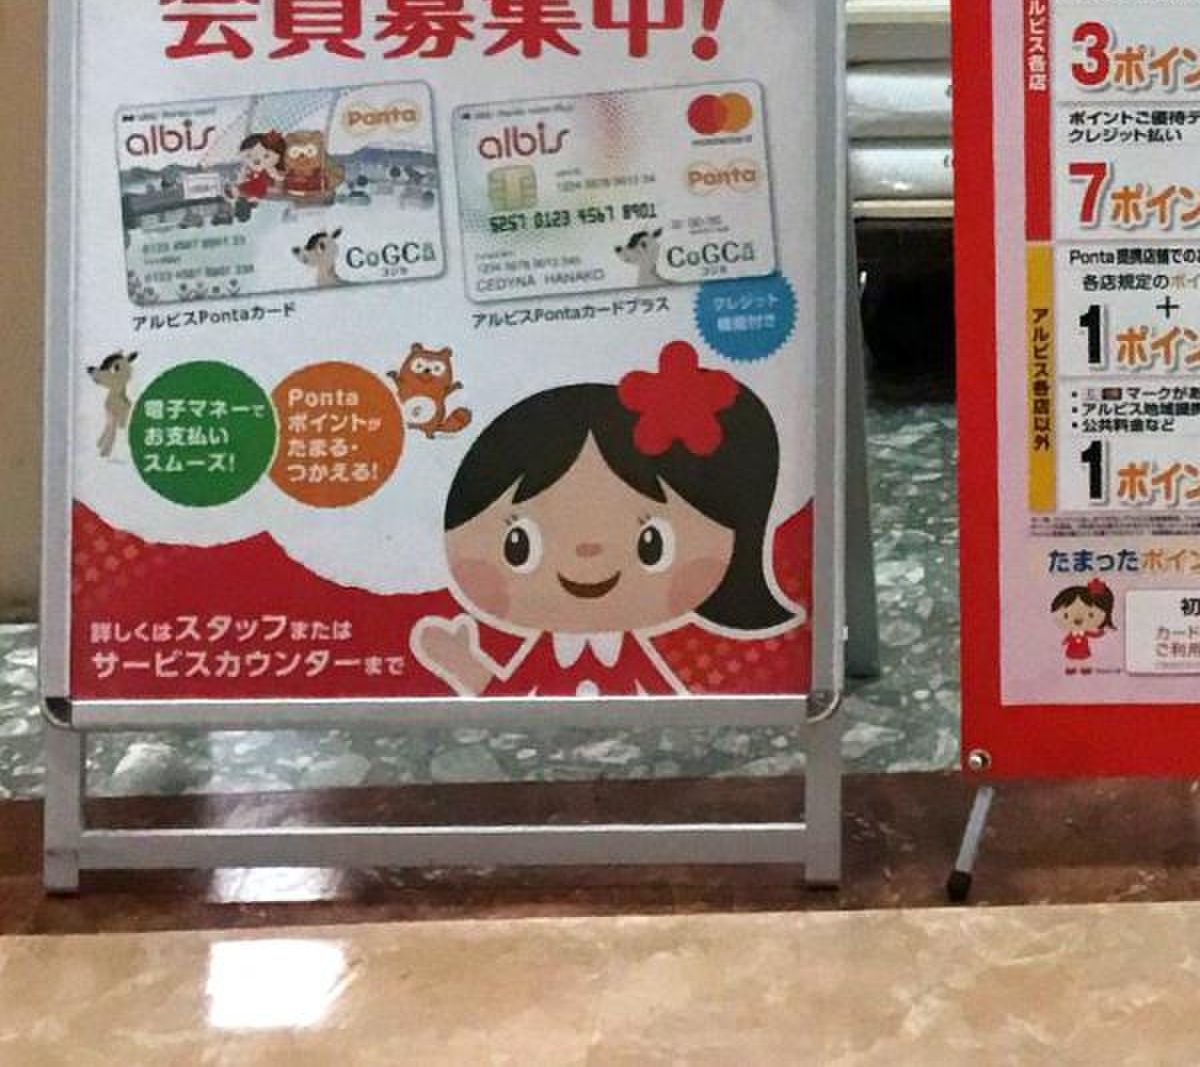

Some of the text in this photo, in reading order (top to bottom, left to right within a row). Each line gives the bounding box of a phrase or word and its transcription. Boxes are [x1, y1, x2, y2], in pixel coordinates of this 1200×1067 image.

[346, 105, 417, 127] Ponta
[1068, 128, 1183, 144] クレジット払い
[132, 302, 297, 331] アルビスPontaカード
[471, 295, 671, 329] アルビスPontaカードプラス
[288, 388, 359, 407] Ponta
[144, 399, 265, 420] 電子マネーで
[288, 412, 380, 433] ポイントが
[144, 427, 229, 447] お支払い
[144, 454, 235, 473] スムーズ!
[288, 463, 378, 484] つかえる!
[90, 616, 352, 643] 詳しくはスタッフまたは
[91, 652, 405, 678] サービスカウンターまで
